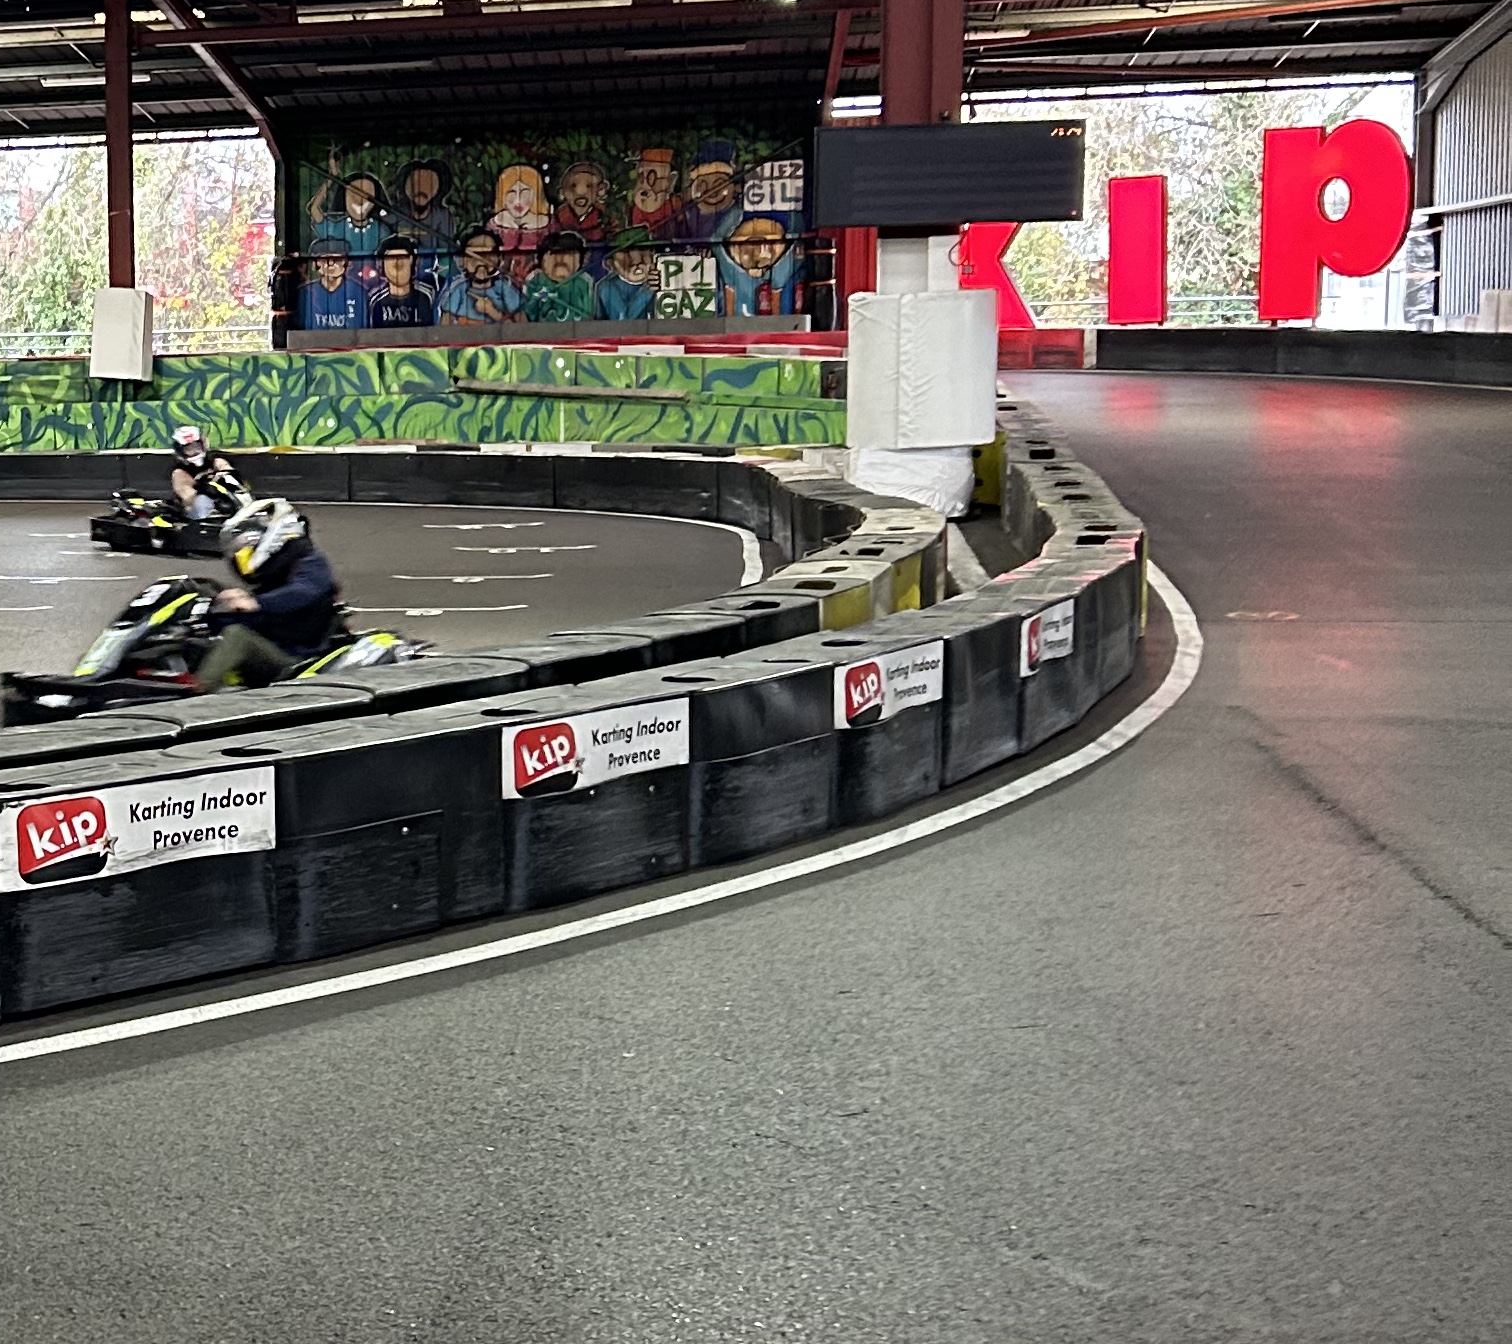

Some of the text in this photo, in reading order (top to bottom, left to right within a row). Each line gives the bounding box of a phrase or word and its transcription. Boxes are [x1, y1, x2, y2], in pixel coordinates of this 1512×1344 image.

[745, 181, 803, 206] GIL
[382, 306, 421, 323] BRASL
[658, 289, 715, 318] GAZ
[591, 717, 682, 747] Karting Indoor
[608, 747, 661, 770] Provence
[129, 788, 267, 823] Karting Indoor
[153, 824, 239, 850] Provence
